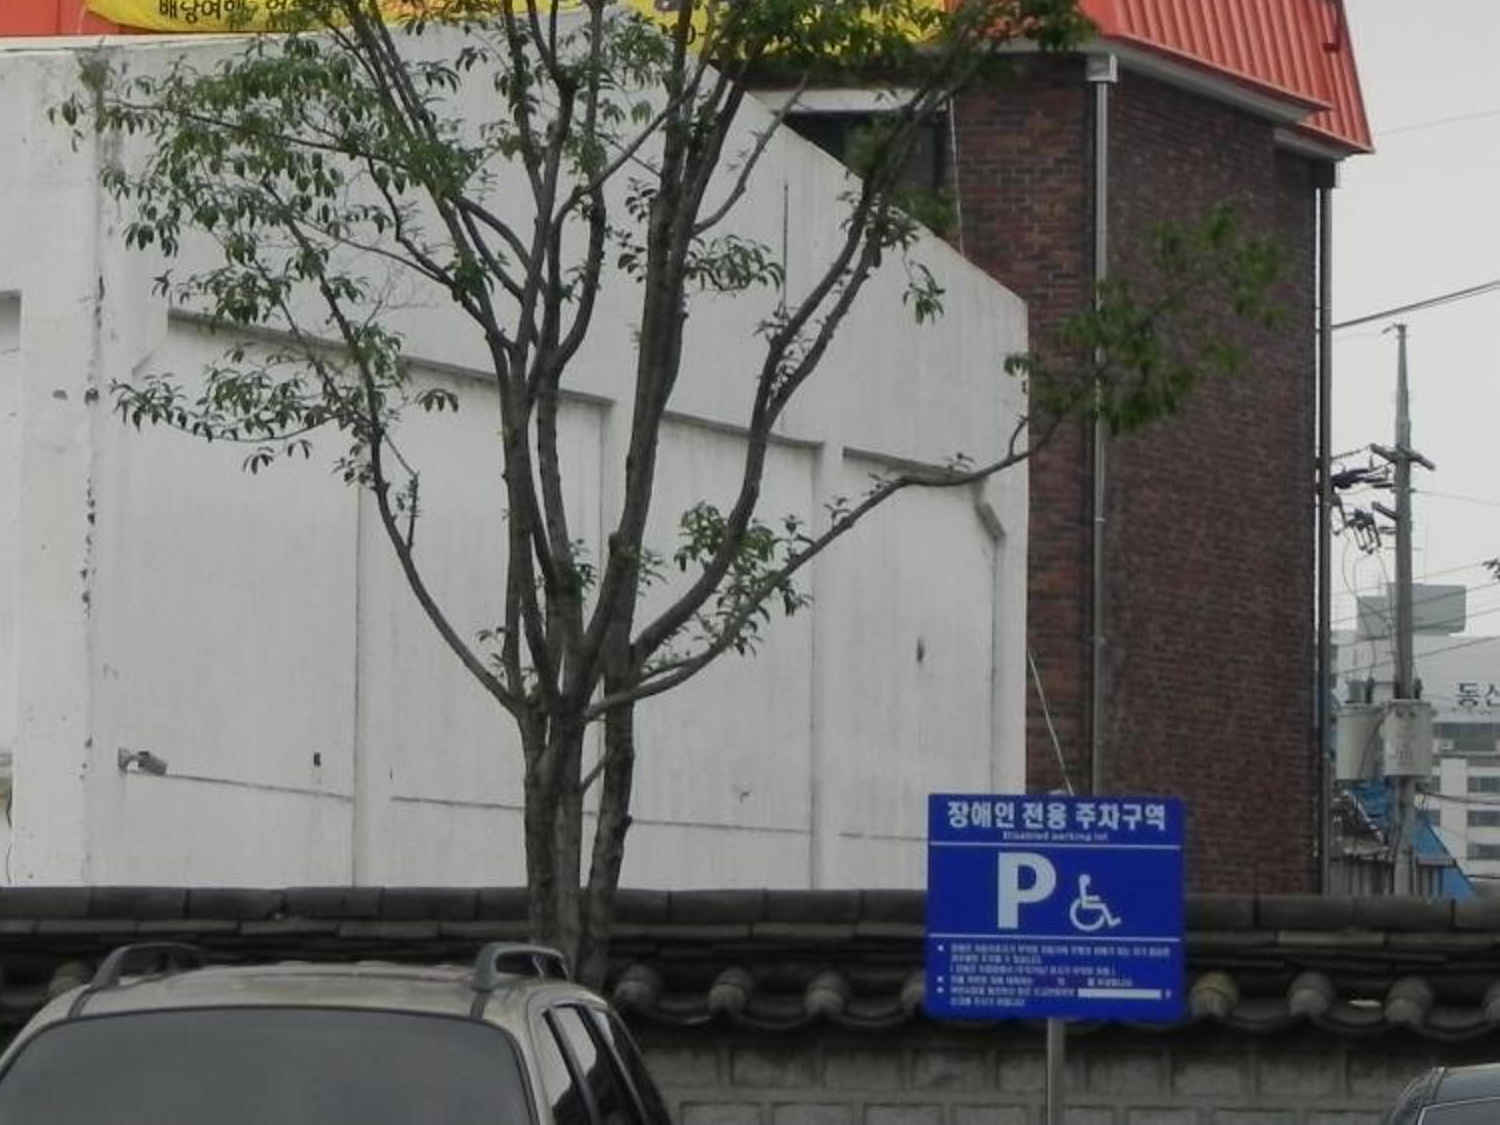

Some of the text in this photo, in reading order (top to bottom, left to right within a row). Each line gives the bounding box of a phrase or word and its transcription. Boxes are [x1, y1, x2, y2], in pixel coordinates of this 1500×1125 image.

[947, 800, 1167, 832] 장애인 전용 주차구역
[997, 851, 1057, 930] P
